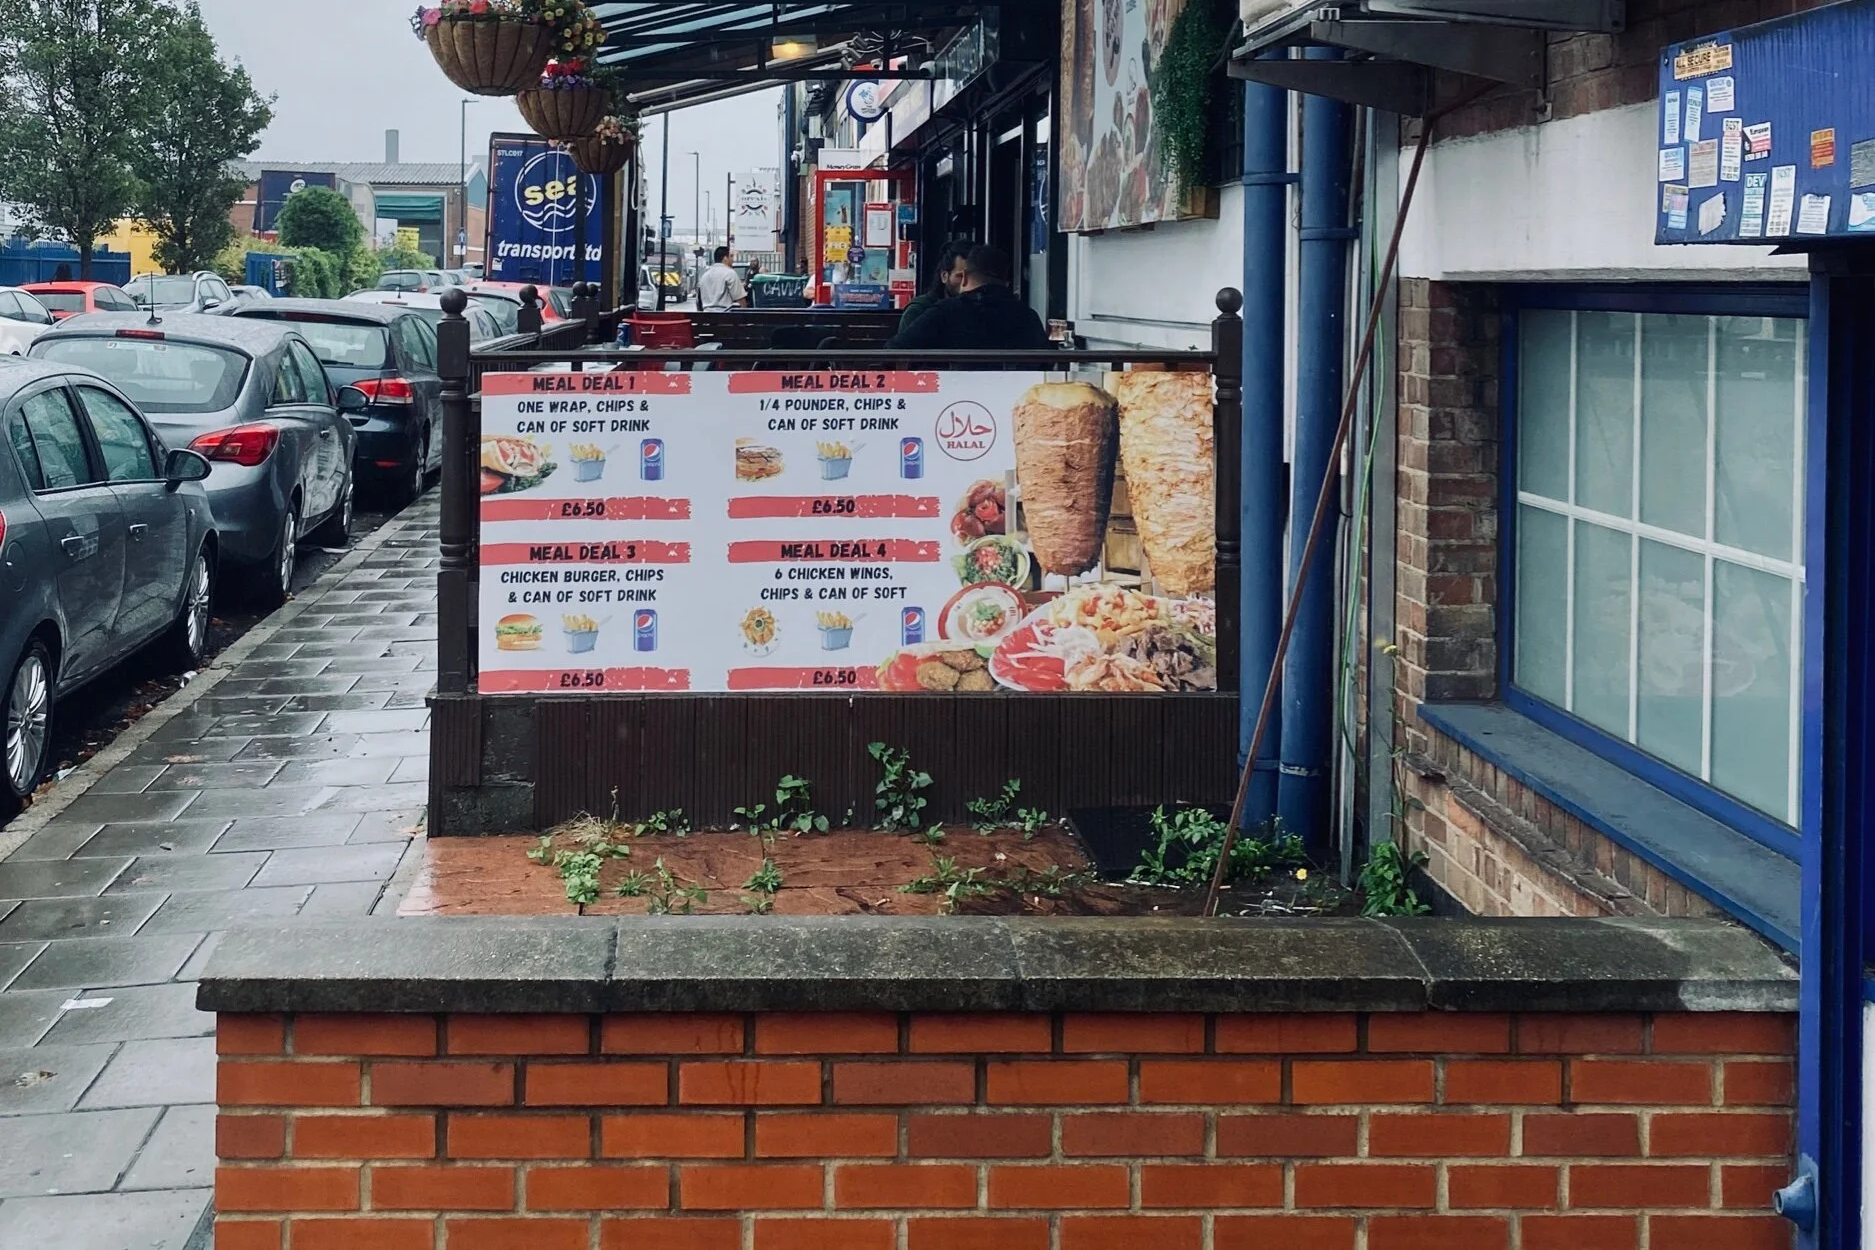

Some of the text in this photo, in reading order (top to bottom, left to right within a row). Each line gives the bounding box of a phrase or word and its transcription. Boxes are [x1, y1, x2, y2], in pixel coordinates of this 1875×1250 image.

[497, 240, 603, 262] transport td
[533, 375, 635, 392] MEAL DEAL 1
[781, 374, 886, 389] MEAL DEAL 2
[517, 399, 649, 414] ONE WRAP, CHIPS &
[759, 398, 906, 412] 1/4 POUNDER, CHIPS &
[516, 419, 650, 434] CAN OF SOFT DRINK
[767, 417, 899, 431] CAN OF SOFT DRINK
[939, 410, 993, 439] حلال
[946, 440, 986, 449] HALAL
[561, 501, 605, 517] £6.50
[812, 498, 856, 514] £6.50
[529, 544, 636, 561] MEAL DEAL 3
[780, 542, 887, 559] MEAL DEAL 4
[500, 568, 664, 584] CHICKEN BURGER, CHIPS
[774, 566, 893, 580] 6 CHICKEN WINGS,
[508, 588, 657, 604] & CAN OF SOFT DRINK
[760, 586, 908, 601] CHIPS & CAN OF SOFT
[560, 672, 604, 688] £6.50
[813, 670, 857, 685] £6.50
